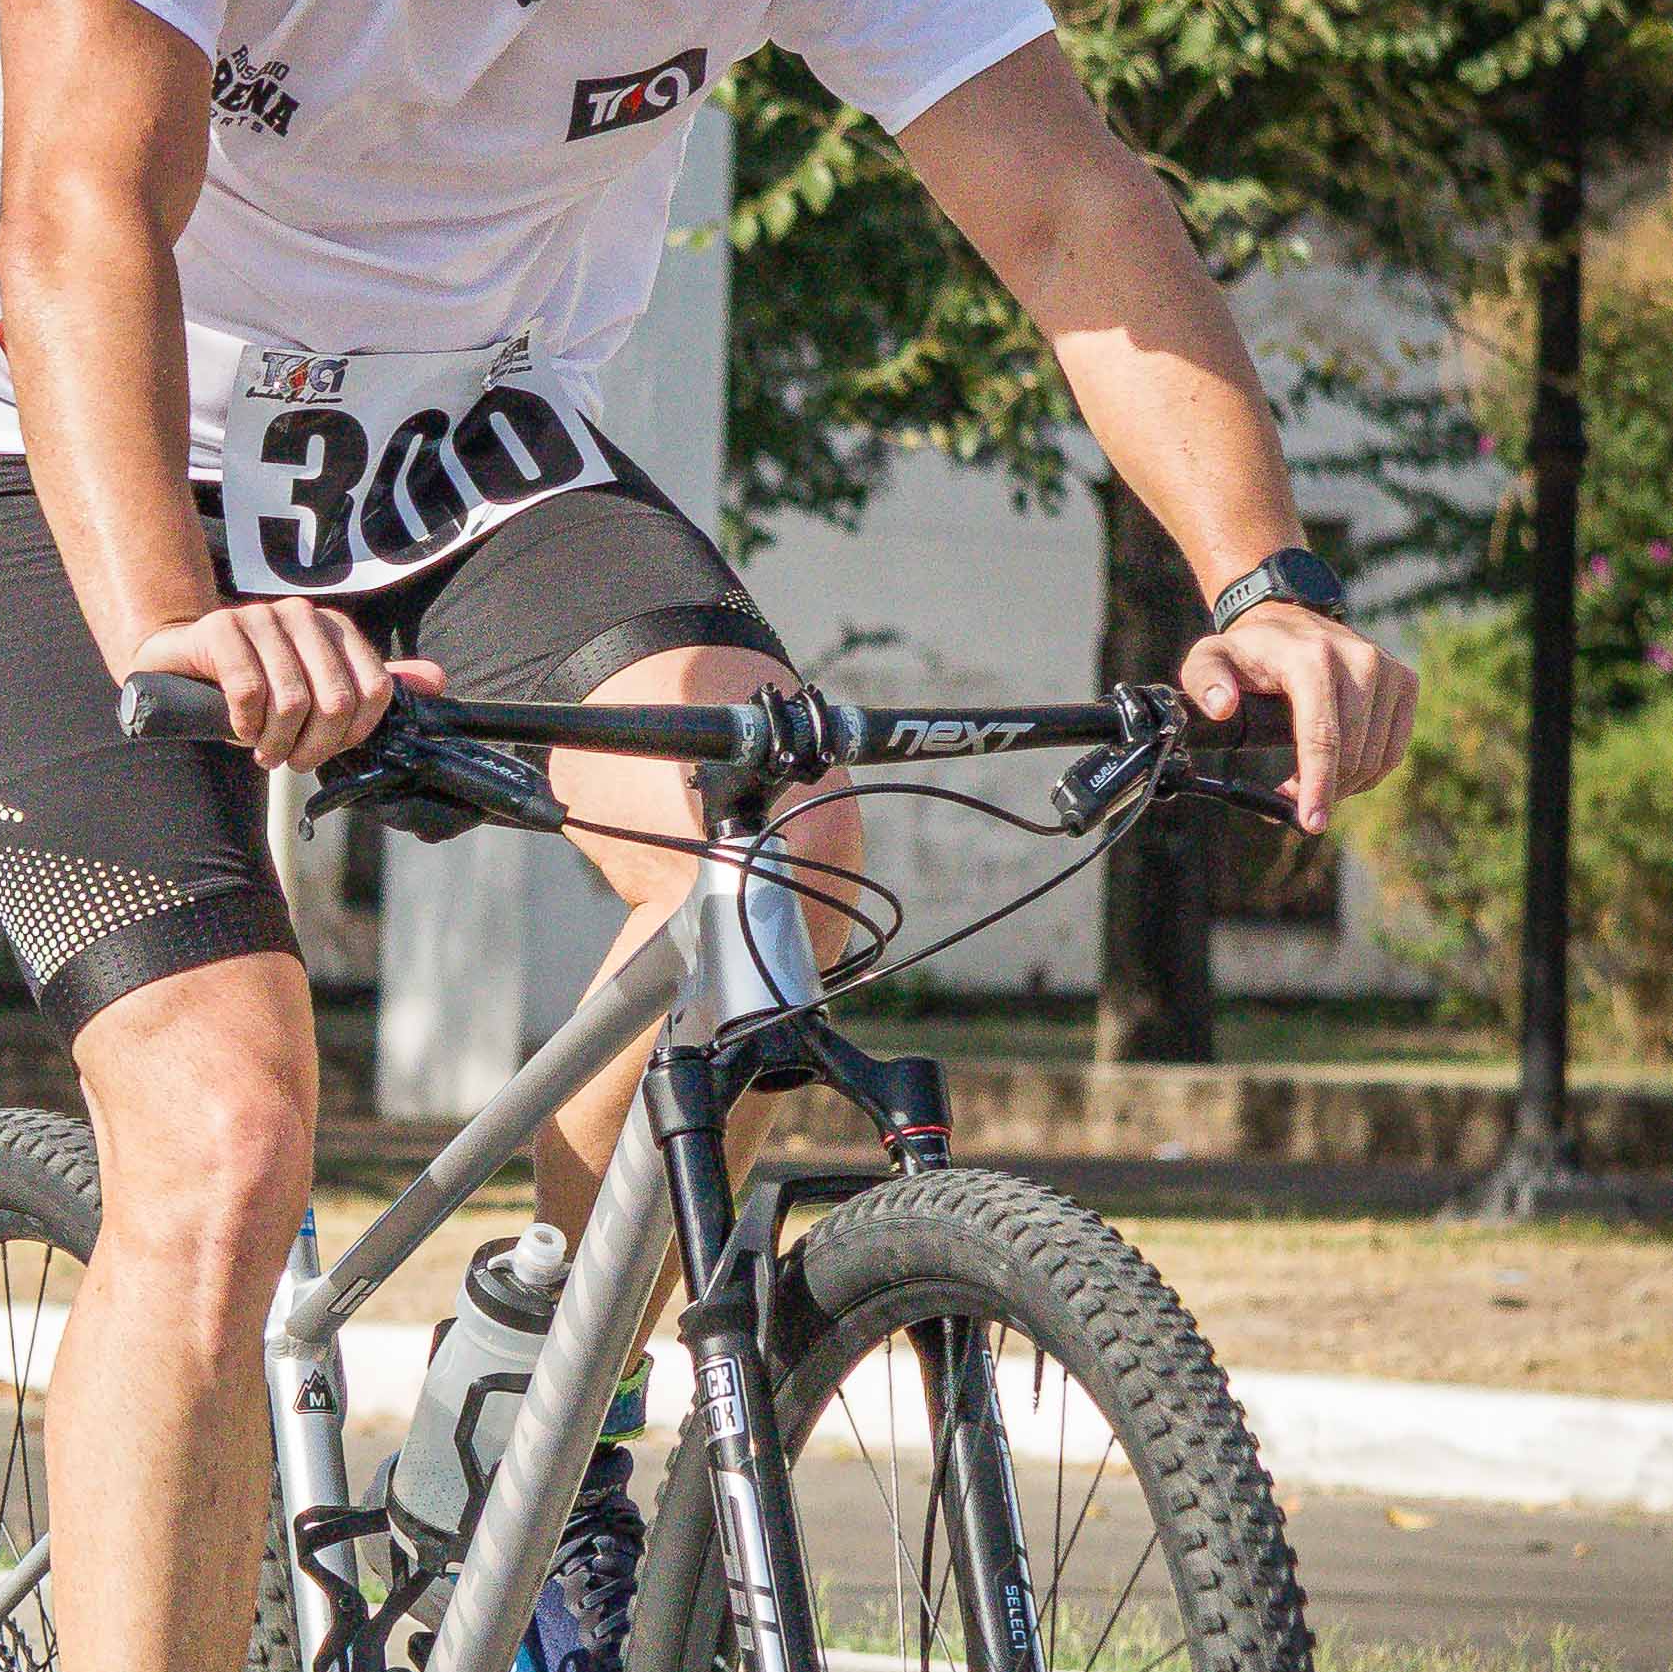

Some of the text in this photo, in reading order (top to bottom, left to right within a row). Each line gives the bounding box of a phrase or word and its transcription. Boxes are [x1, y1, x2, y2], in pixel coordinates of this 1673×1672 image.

[211, 58, 302, 138] RENA
[259, 384, 585, 588] 300
[698, 1365, 733, 1401] OCK
[1004, 1584, 1028, 1652] SELECT
